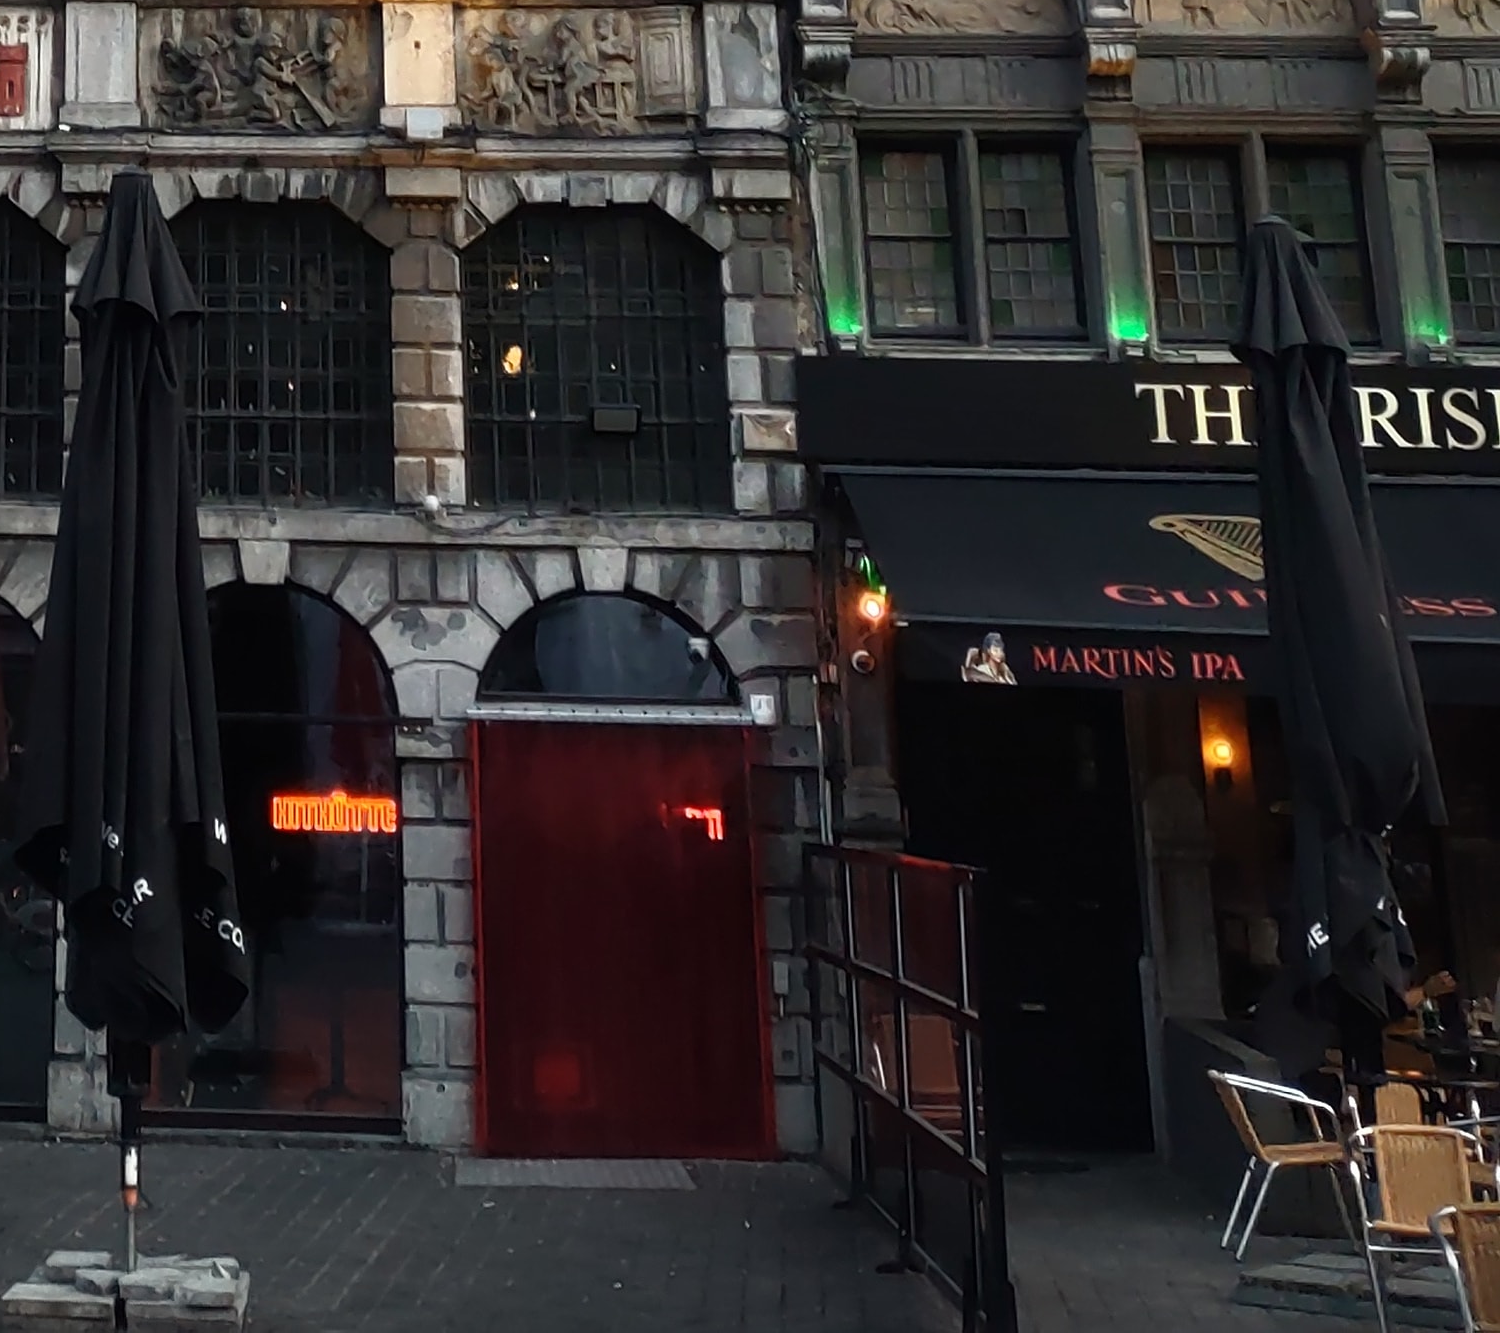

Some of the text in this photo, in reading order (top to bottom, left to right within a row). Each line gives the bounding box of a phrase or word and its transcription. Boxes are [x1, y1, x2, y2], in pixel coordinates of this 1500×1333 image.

[1134, 382, 1500, 451] TH RIS
[1032, 644, 1246, 681] MARTIN'S IPA
